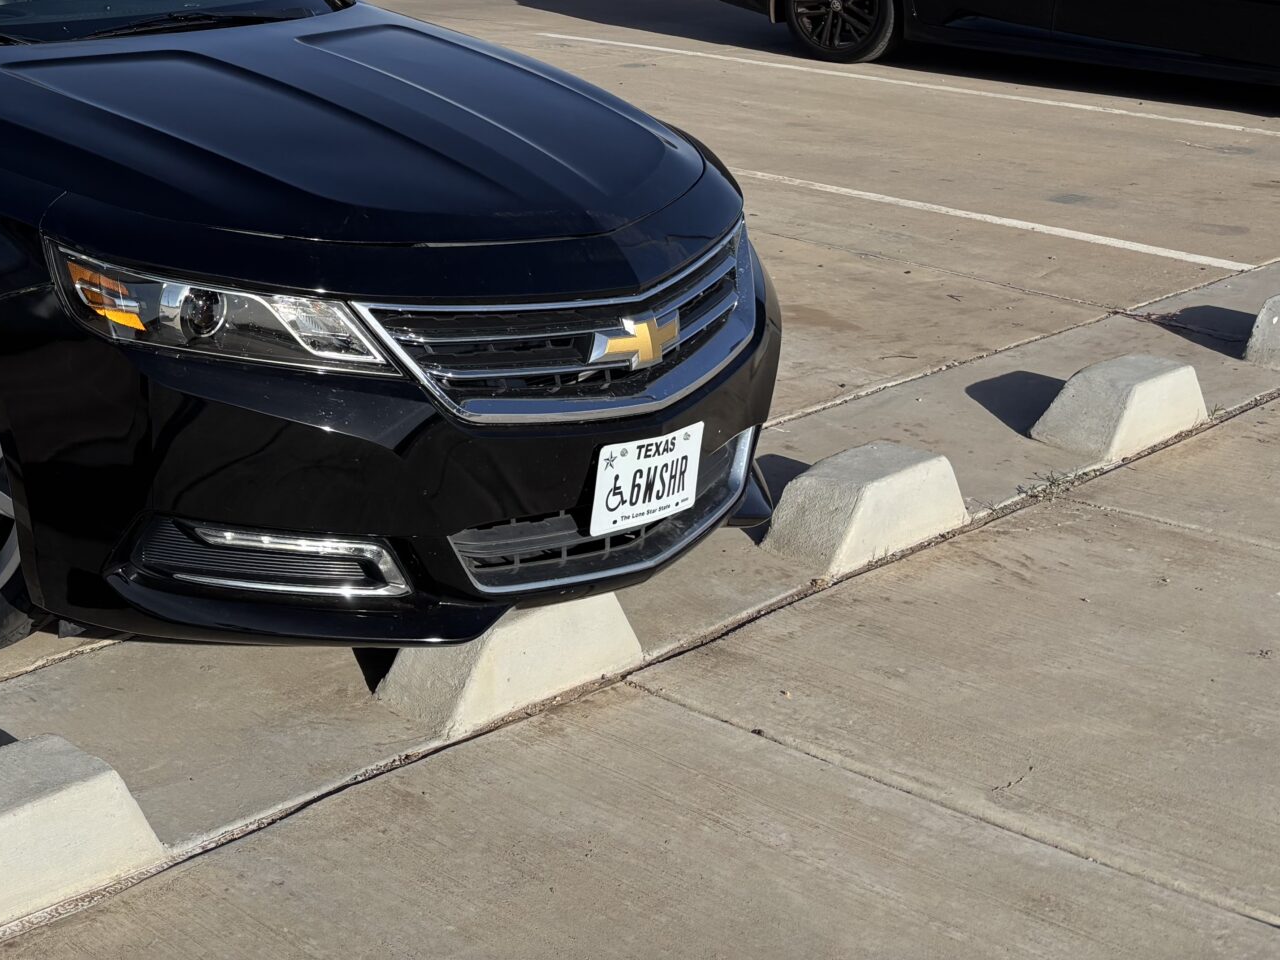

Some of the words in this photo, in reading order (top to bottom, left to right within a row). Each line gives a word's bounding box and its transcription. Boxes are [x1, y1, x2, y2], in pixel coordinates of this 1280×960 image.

[635, 436, 677, 460] TEXAS
[629, 455, 689, 507] 6WSHR
[631, 511, 646, 519] Lone
[646, 508, 658, 516] Star
